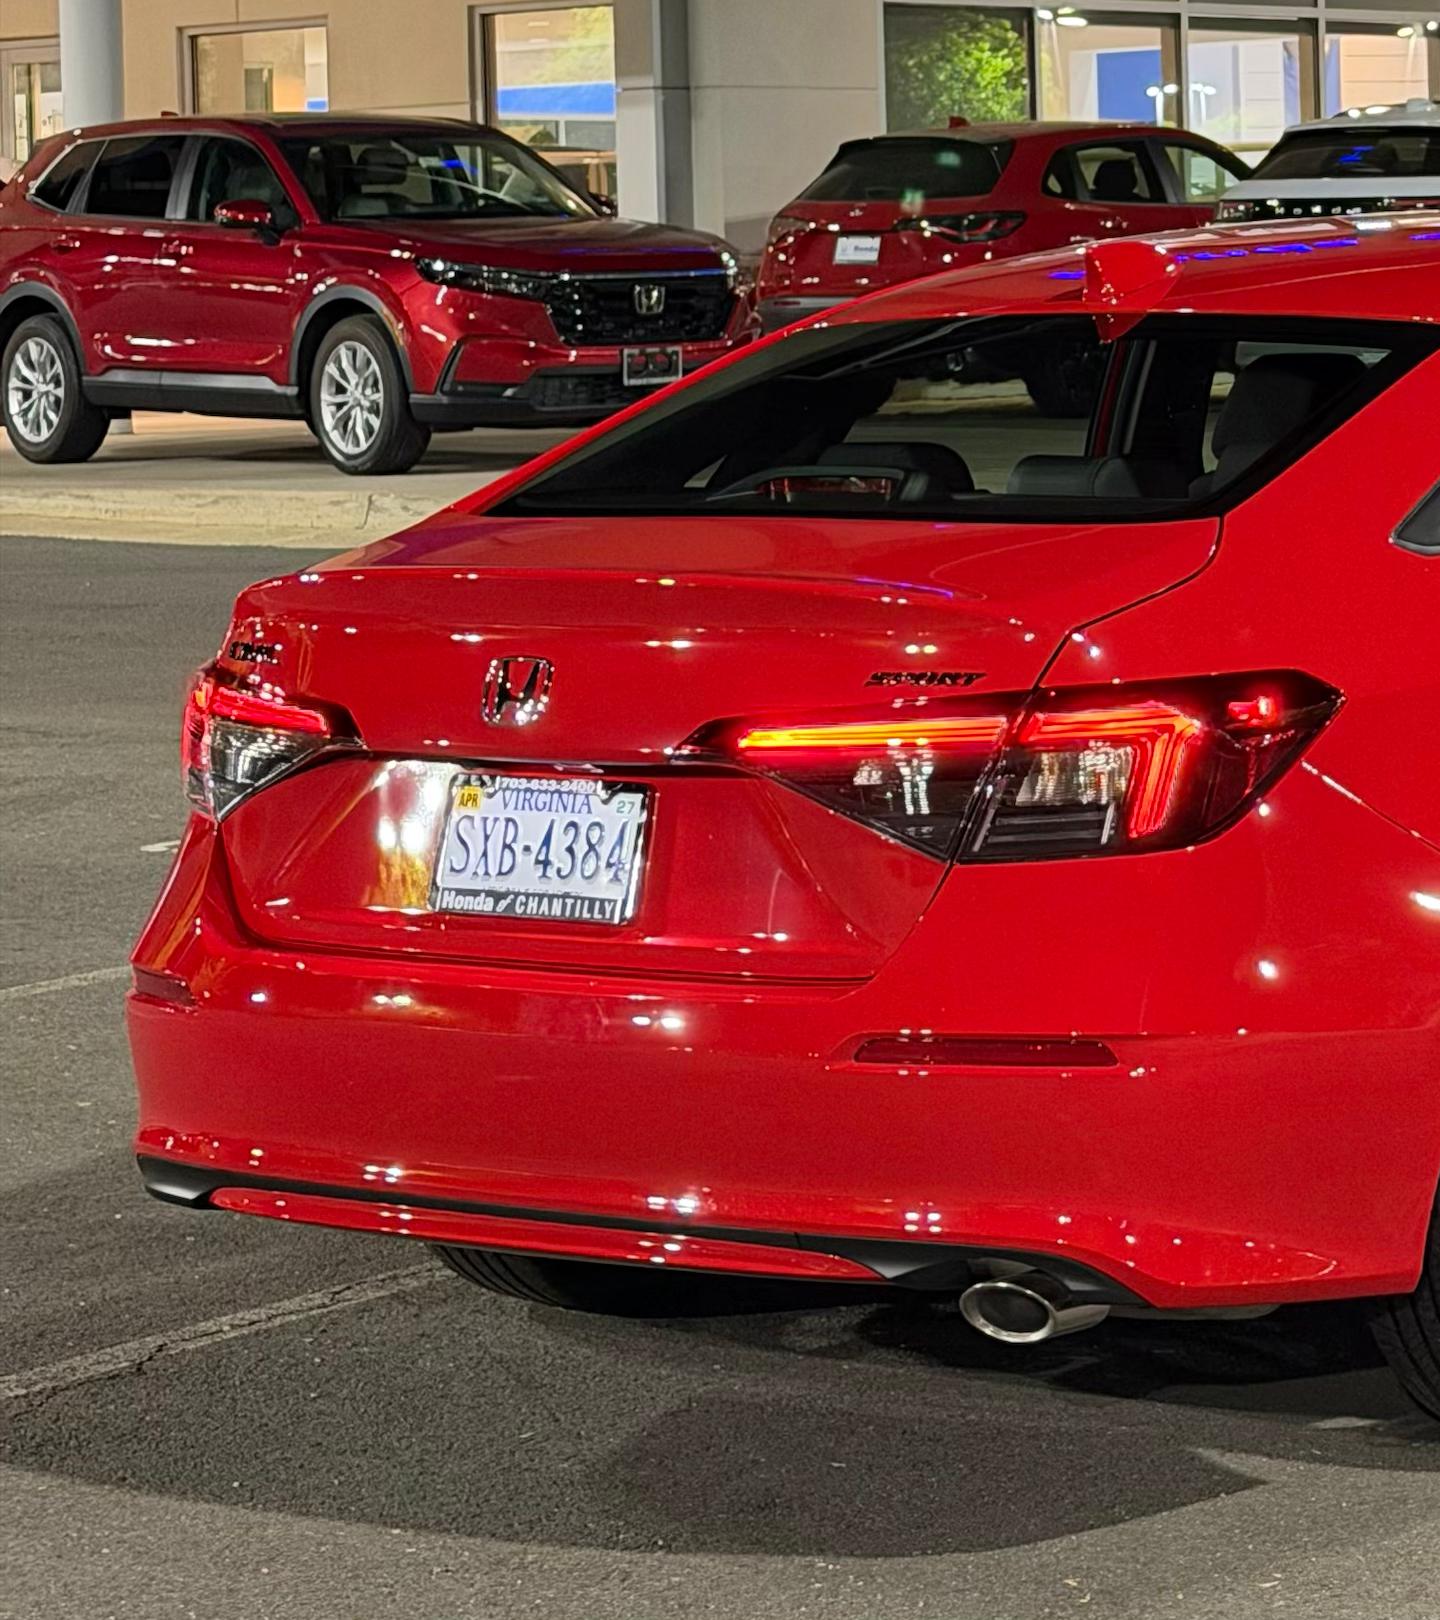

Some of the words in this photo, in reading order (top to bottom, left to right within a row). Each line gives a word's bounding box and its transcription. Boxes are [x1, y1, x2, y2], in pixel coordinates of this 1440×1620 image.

[863, 671, 988, 688] SPORT
[457, 793, 479, 808] APR
[500, 788, 593, 815] VIRGINIA
[616, 800, 635, 814] 27
[449, 814, 631, 884] SXB-4384
[441, 890, 494, 912] Honda
[495, 894, 515, 912] of
[514, 895, 615, 919] CHANTILLY
